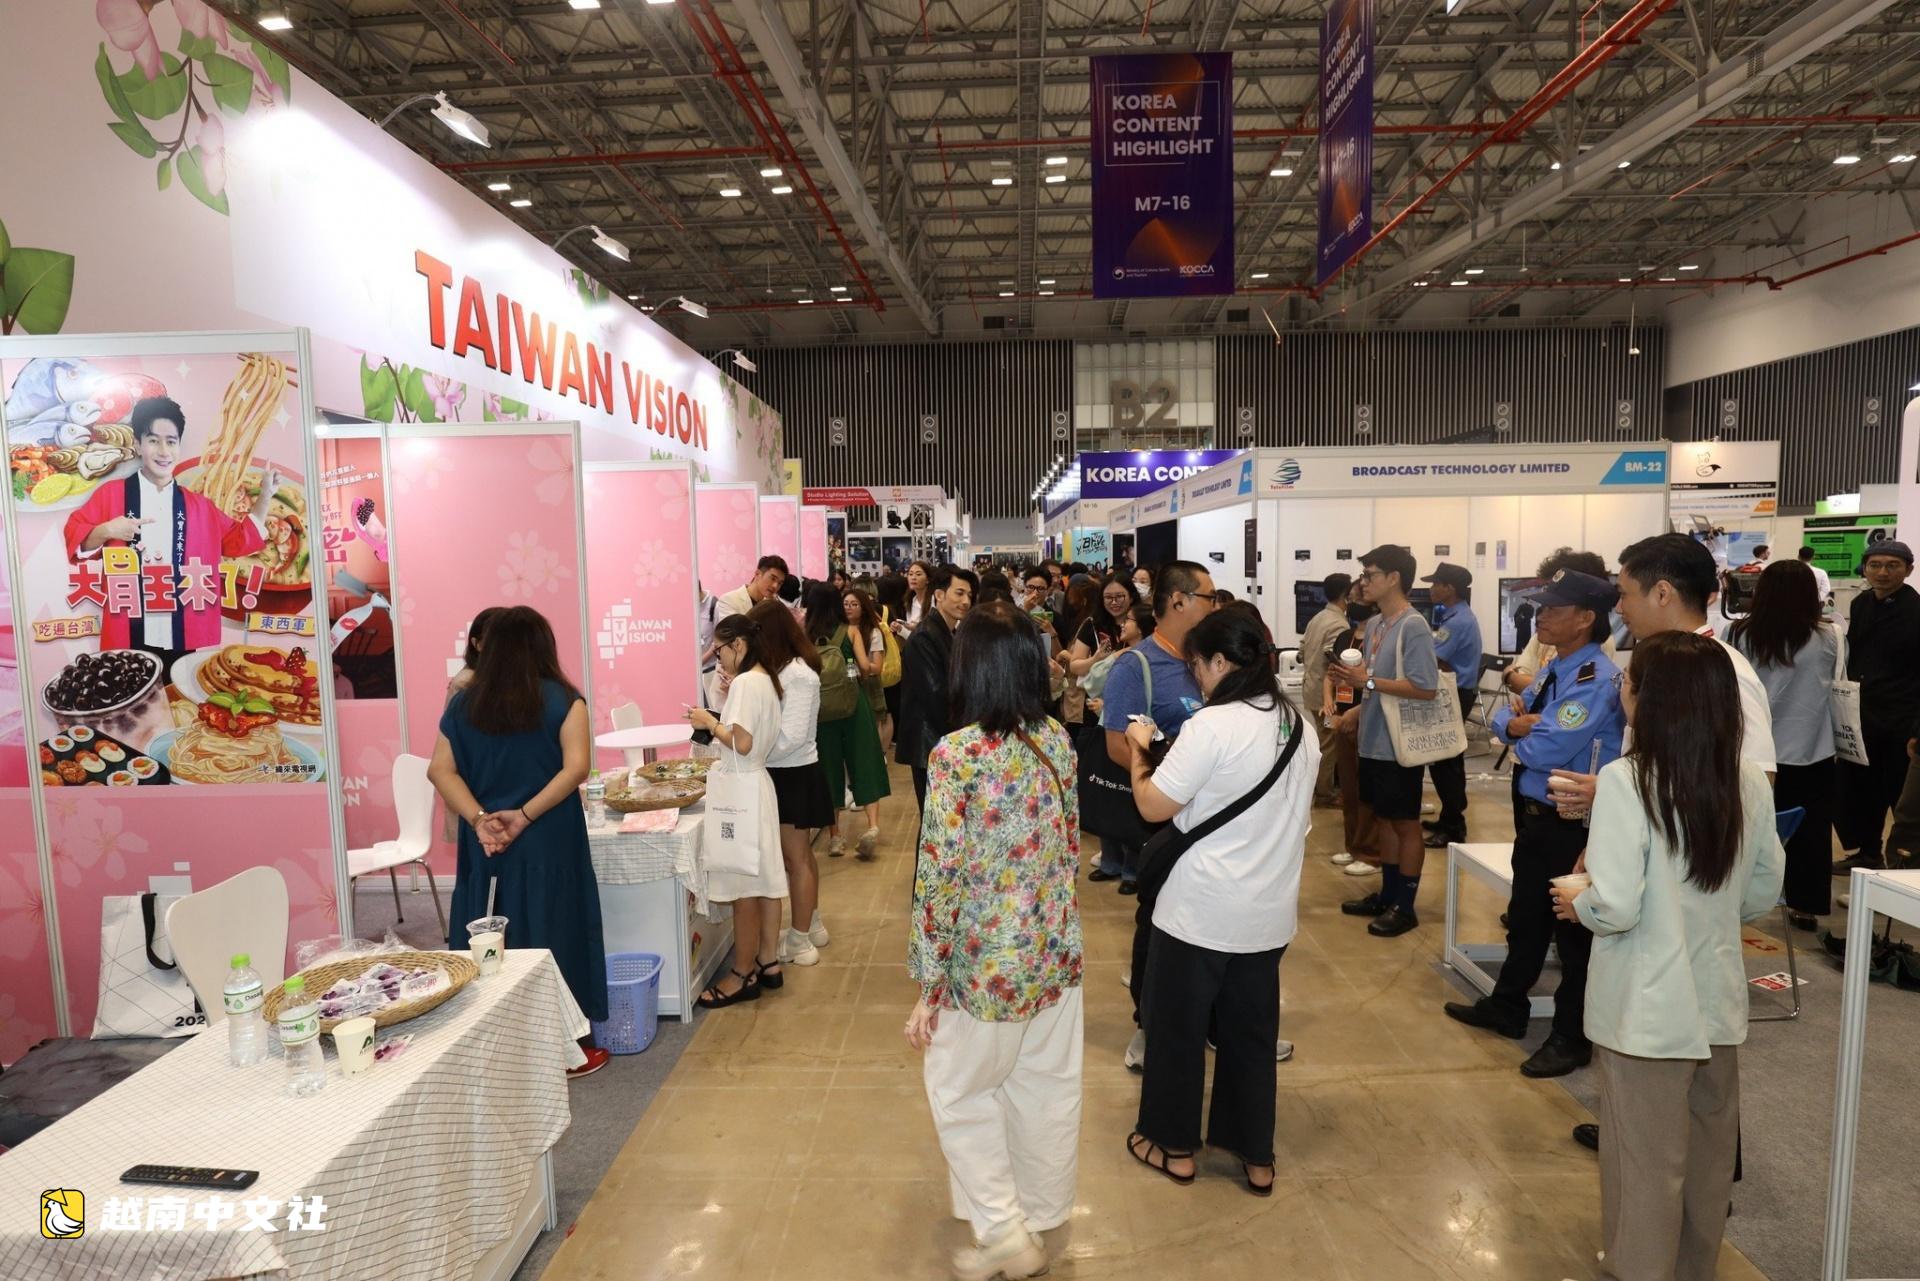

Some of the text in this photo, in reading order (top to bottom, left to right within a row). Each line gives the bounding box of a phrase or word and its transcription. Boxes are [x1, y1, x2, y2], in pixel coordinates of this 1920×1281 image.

[1325, 25, 1351, 72] KOREA
[1325, 33, 1361, 98] CONTENT
[1325, 55, 1366, 125] HIGHLIGHT
[1112, 94, 1177, 110] KOREA
[1112, 116, 1203, 133] CONTENT
[1113, 139, 1214, 157] HIGHLIGHT
[1135, 195, 1191, 212] M7-16
[1179, 265, 1215, 274] KOCCA
[414, 249, 708, 451] TAIWAN VISION
[1110, 379, 1178, 428] B2
[1086, 466, 1151, 482] KOREA
[1352, 461, 1663, 476] BROADCAST TECHNOLOGY LIMITED BM-22
[39, 620, 94, 637] 吃遍台灣
